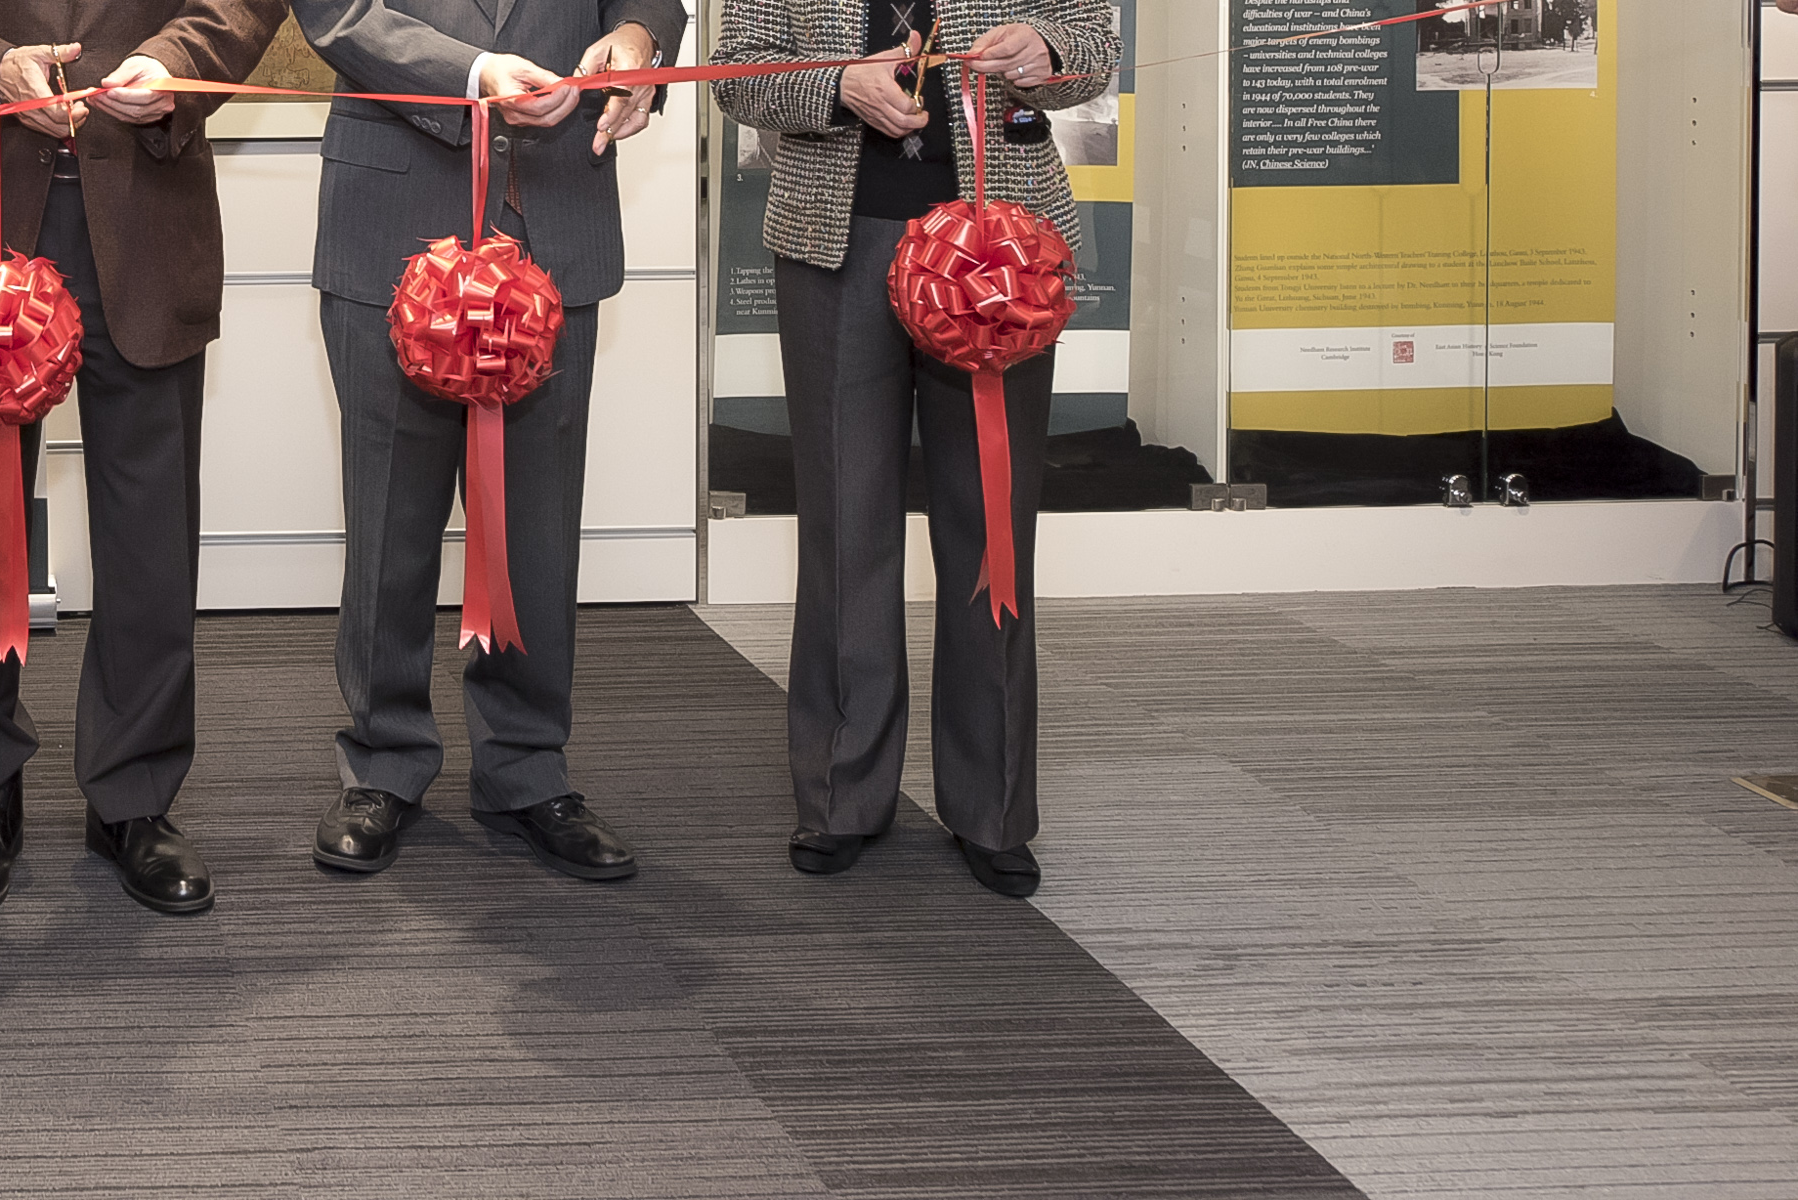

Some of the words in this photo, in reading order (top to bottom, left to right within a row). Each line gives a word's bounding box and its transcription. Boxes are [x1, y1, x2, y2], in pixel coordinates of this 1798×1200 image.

[1243, 9, 1282, 20] difficulties
[1283, 9, 1295, 19] of
[1321, 8, 1339, 18] and
[1243, 22, 1289, 32] educational
[1290, 22, 1338, 31] institutions
[1309, 37, 1337, 46] enemy
[1338, 35, 1380, 46] bombings
[1249, 50, 1297, 59] universities
[1297, 50, 1314, 59] and
[1316, 50, 1354, 59] technical
[1355, 49, 1388, 60] colleges
[1242, 64, 1261, 73] have
[1262, 64, 1302, 73] increased
[1302, 63, 1325, 74] from
[1326, 63, 1343, 72] 108
[1343, 64, 1379, 74] pre-war
[1242, 77, 1250, 86] to
[1251, 79, 1265, 88] 143
[1266, 77, 1293, 88] today,
[1294, 77, 1314, 86] with
[1323, 76, 1344, 85] total
[1344, 76, 1387, 85] enrolment
[1243, 91, 1250, 100] in
[1251, 92, 1270, 101] 1944
[1271, 90, 1282, 102] of
[1282, 92, 1312, 101] 70,000
[1313, 90, 1352, 99] students.
[1353, 90, 1374, 100] They
[1242, 106, 1255, 114] are
[1275, 104, 1317, 115] dispersed
[1317, 103, 1365, 115] throughout
[1366, 103, 1380, 112] the
[1283, 118, 1293, 127] In
[1294, 118, 1307, 127] all
[1307, 118, 1327, 127] Free
[1328, 117, 1352, 126] China
[1354, 117, 1377, 126] there
[1242, 134, 1255, 142] are
[1256, 132, 1275, 143] only
[1283, 133, 1302, 143] very
[1302, 131, 1321, 142] few
[1321, 131, 1355, 142] colleges
[1355, 131, 1381, 140] which
[1242, 145, 1266, 155] retain
[1267, 145, 1288, 155] their
[1288, 147, 1324, 157] pre-war
[1260, 159, 1292, 168] Chinese
[1293, 159, 1329, 168] Science)
